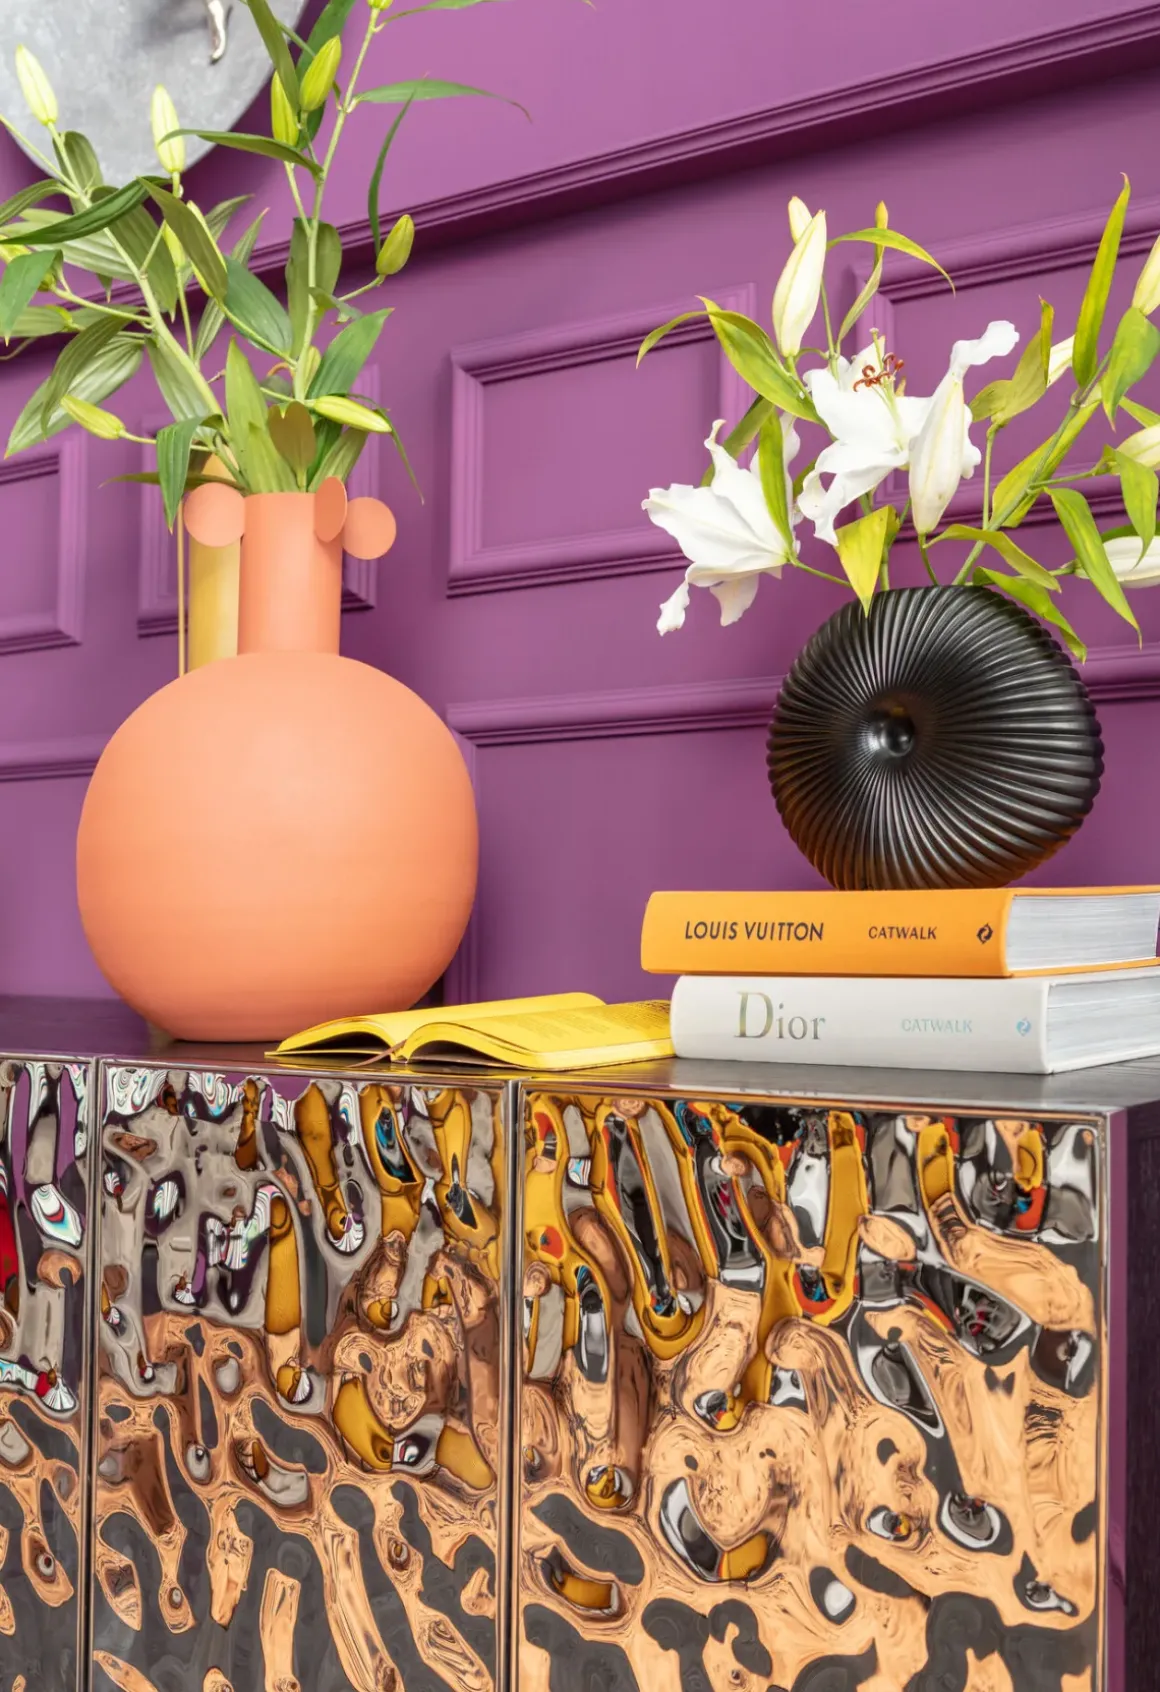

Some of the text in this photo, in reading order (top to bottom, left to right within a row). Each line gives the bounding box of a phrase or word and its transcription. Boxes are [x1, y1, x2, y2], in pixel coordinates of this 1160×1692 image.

[685, 921, 824, 941] LOUIS VUITTON
[868, 926, 937, 940] CATWALK
[733, 991, 826, 1040] Dior
[901, 1019, 972, 1034] CATWALK
